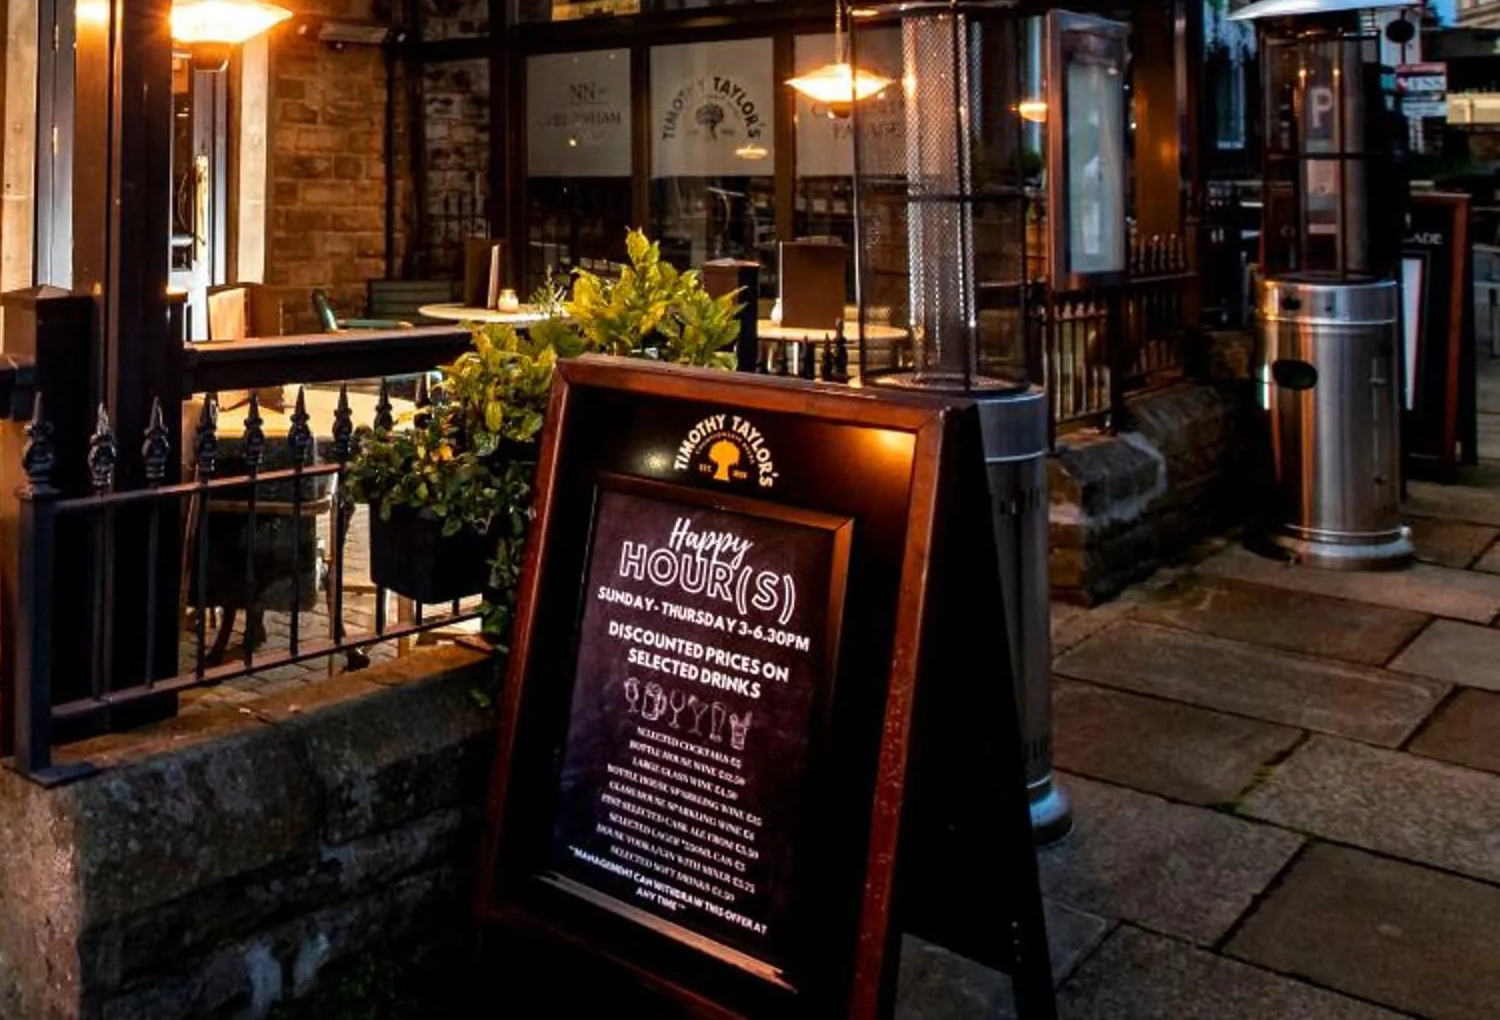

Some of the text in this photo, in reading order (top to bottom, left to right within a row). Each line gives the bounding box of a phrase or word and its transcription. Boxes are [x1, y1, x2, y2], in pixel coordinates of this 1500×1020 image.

[714, 76, 766, 139] TAYLOR'S
[674, 414, 726, 470] TIMOTHY
[731, 415, 779, 487] TAYLOR'S
[668, 517, 753, 568] Happy
[619, 542, 796, 624] HOUR(S)
[609, 620, 788, 681] DISCOUNTED PRICES ON
[661, 601, 738, 632] THURSDAY
[738, 620, 810, 651] 3-6.30PM
[628, 647, 761, 698] SELECTED DRINKS
[636, 885, 656, 901] ANY
